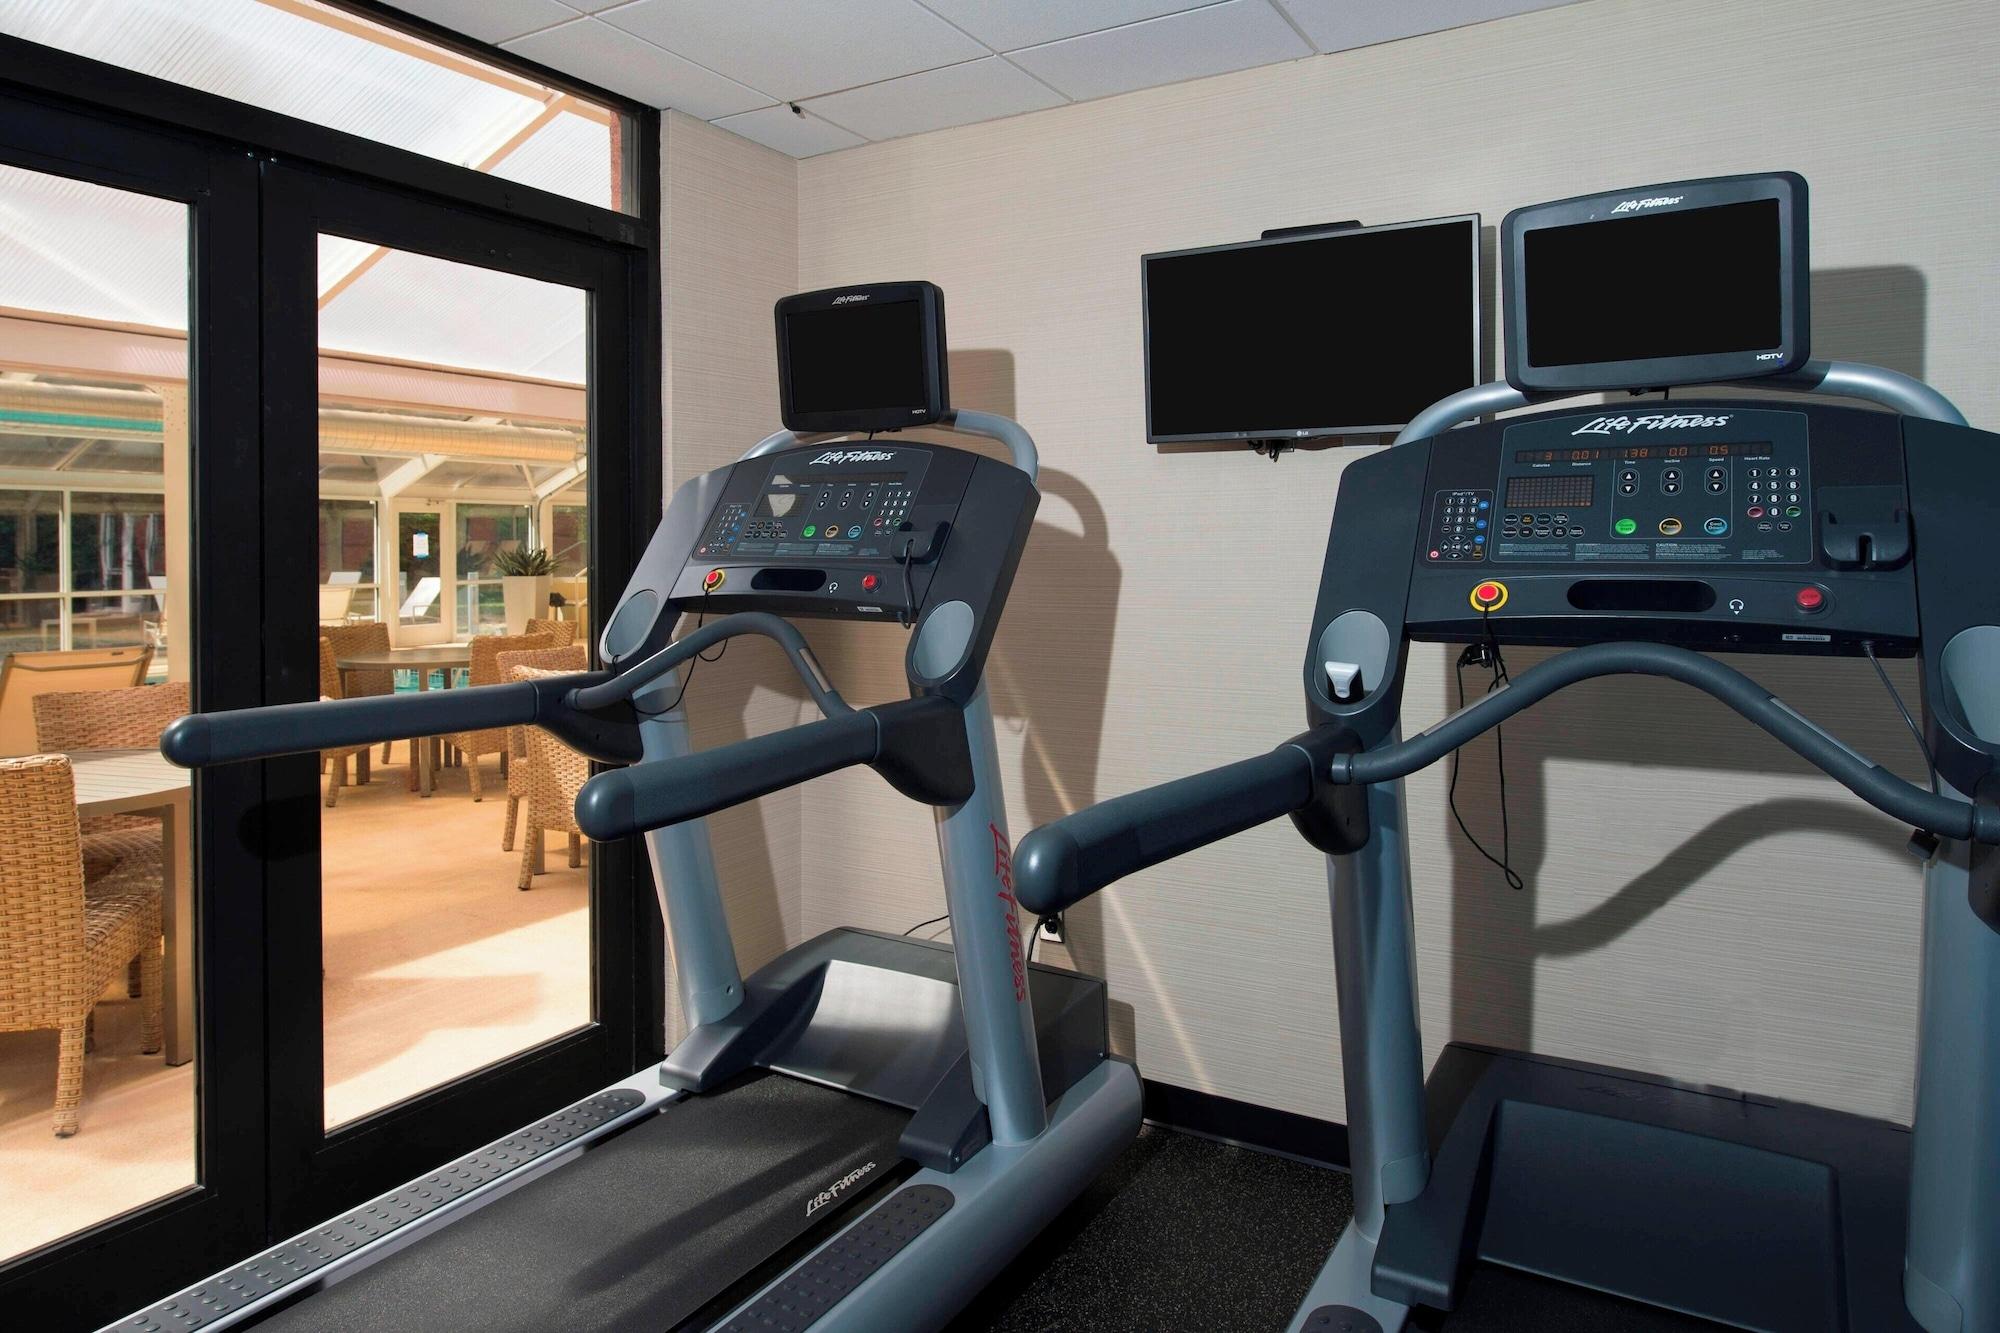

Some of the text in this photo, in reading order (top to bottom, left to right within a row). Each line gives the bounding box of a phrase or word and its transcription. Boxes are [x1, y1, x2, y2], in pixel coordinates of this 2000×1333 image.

[1756, 352, 1784, 361] HDTV
[1789, 468, 1796, 476] 3
[1789, 481, 1797, 489] 6
[1770, 495, 1778, 503] 8
[1790, 494, 1797, 502] 9
[1771, 508, 1778, 516] 0
